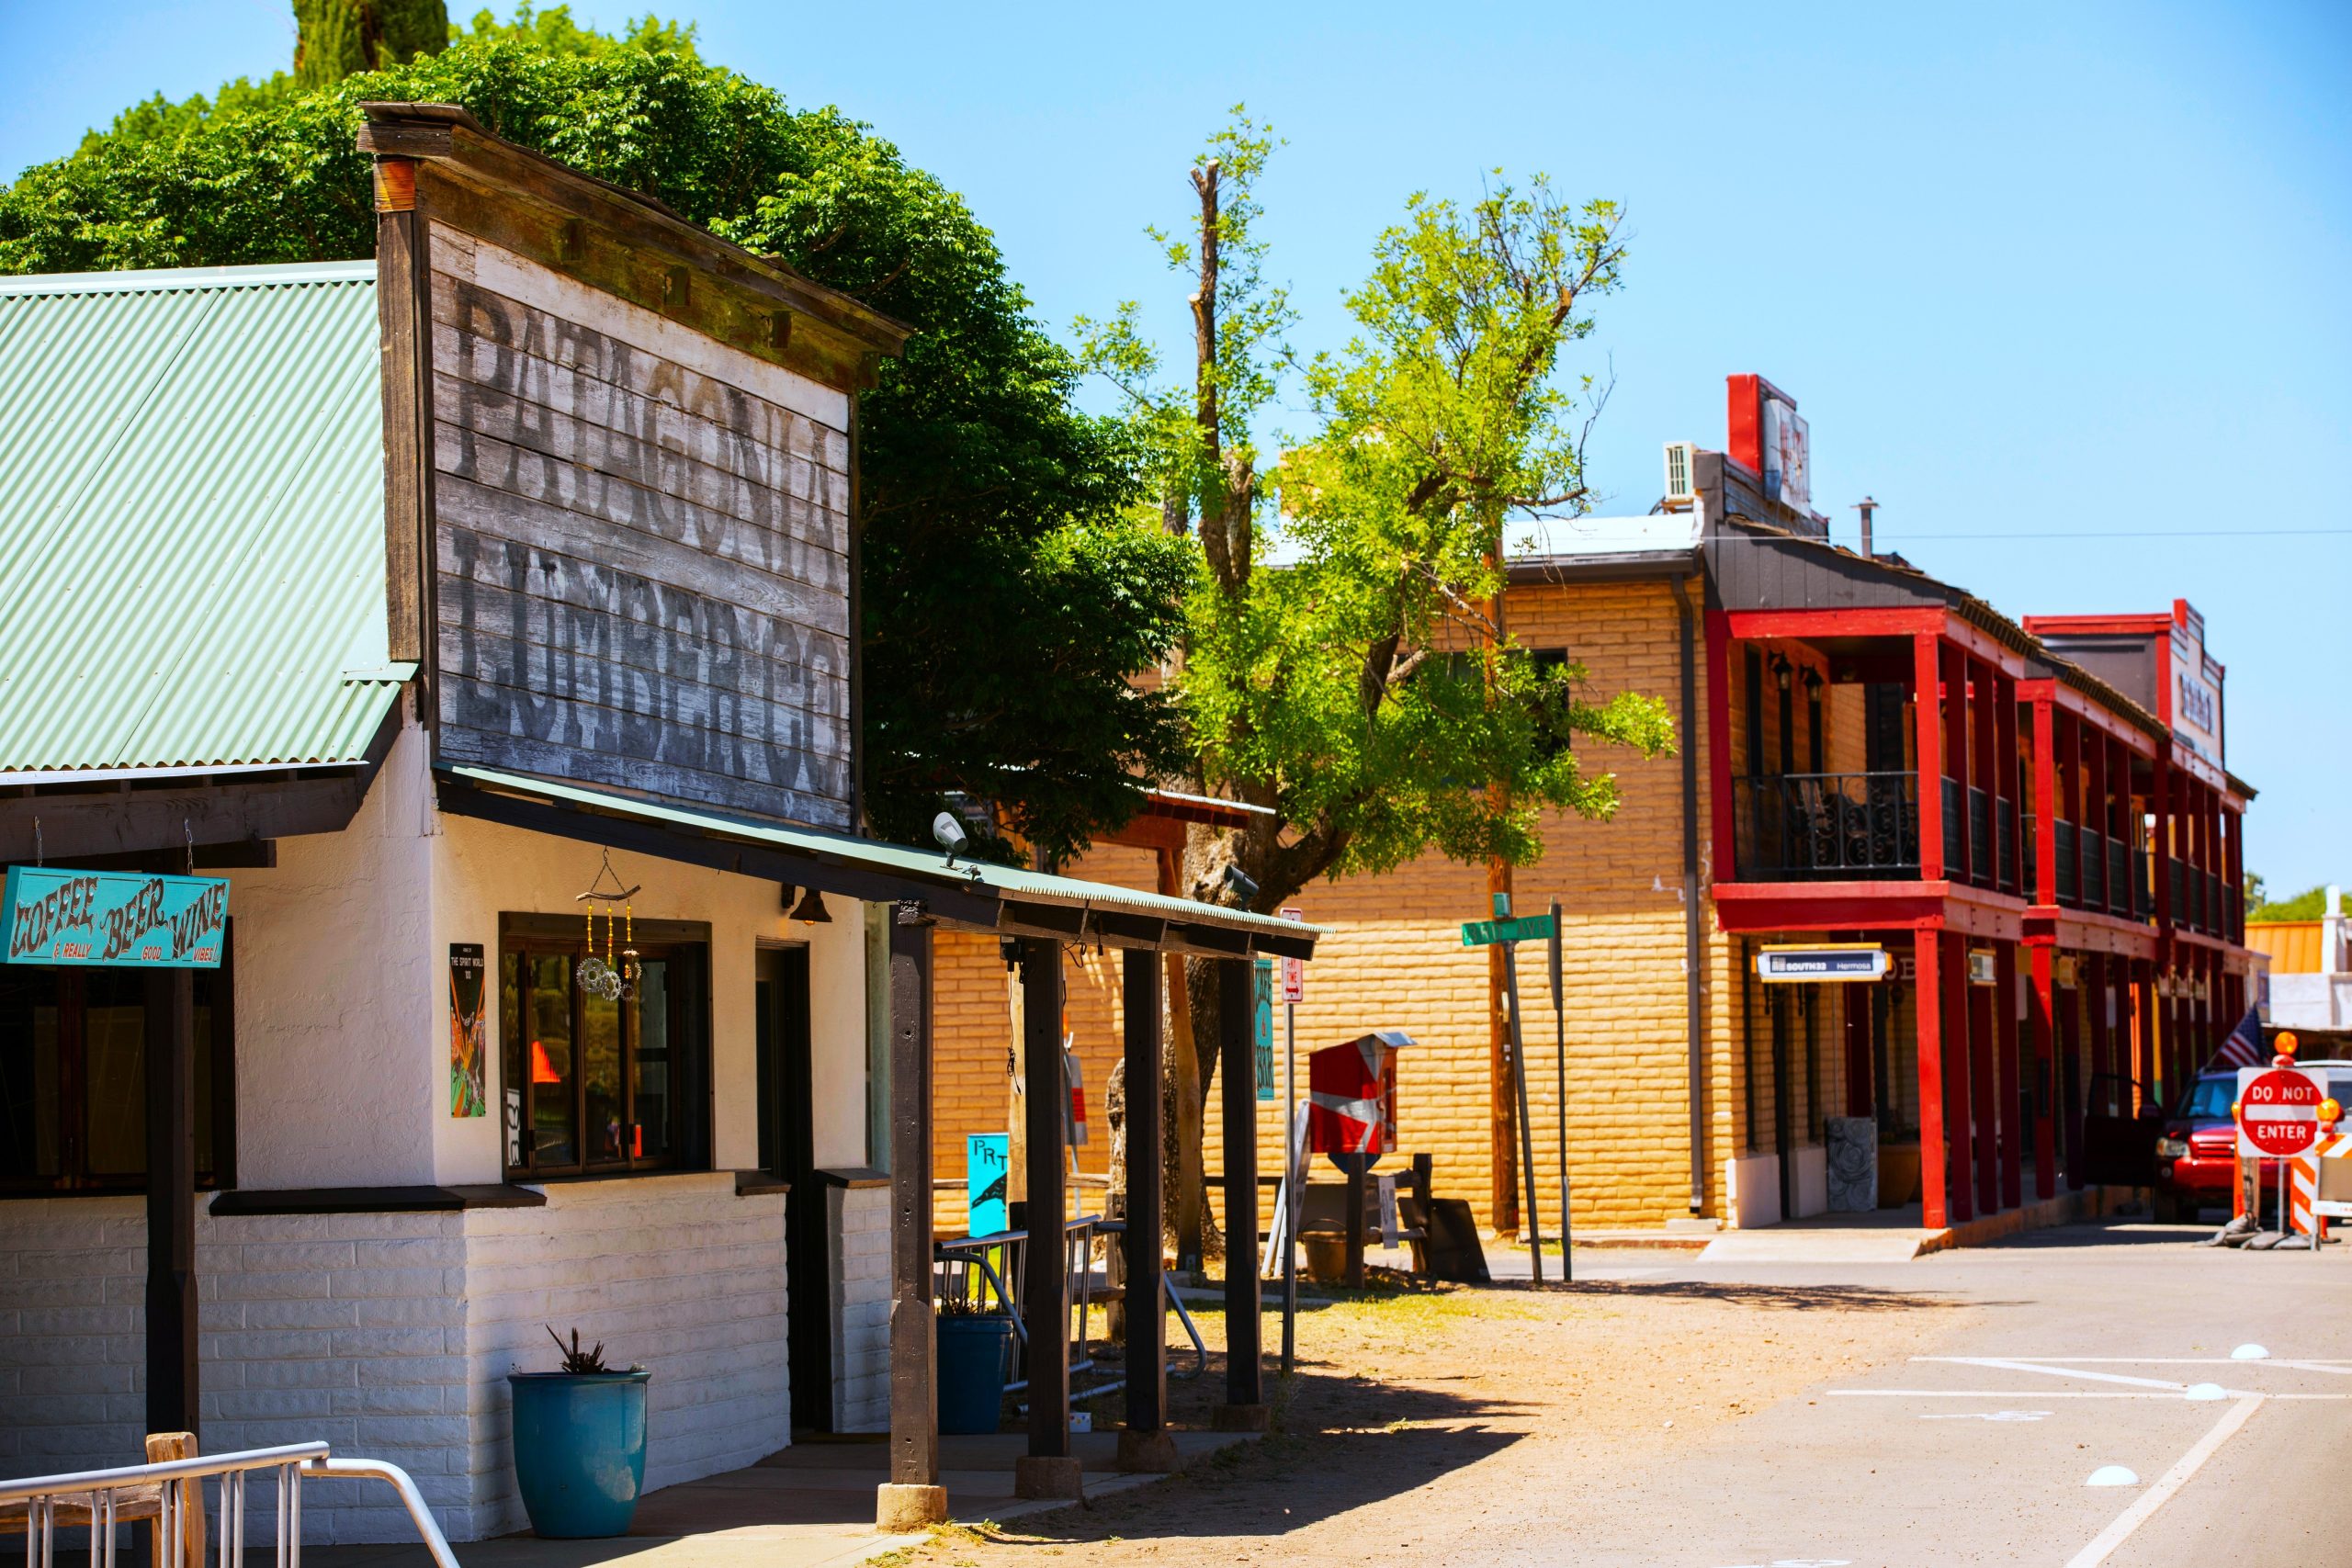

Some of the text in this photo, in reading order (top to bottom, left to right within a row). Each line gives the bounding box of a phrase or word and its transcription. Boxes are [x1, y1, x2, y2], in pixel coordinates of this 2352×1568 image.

[452, 279, 842, 594] PATAGONIA
[452, 527, 745, 780] LUMBER
[11, 875, 227, 962] COFFEE BEER WINE
[1469, 919, 1548, 942] 3RD AVE
[62, 942, 92, 958] REALLY
[142, 946, 163, 961] GOOD
[450, 956, 458, 965] THE
[472, 957, 484, 967] WORLD
[1837, 961, 1871, 971] Hermosa
[2252, 1086, 2313, 1101] DO NOT
[2256, 1125, 2307, 1140] ENTER
